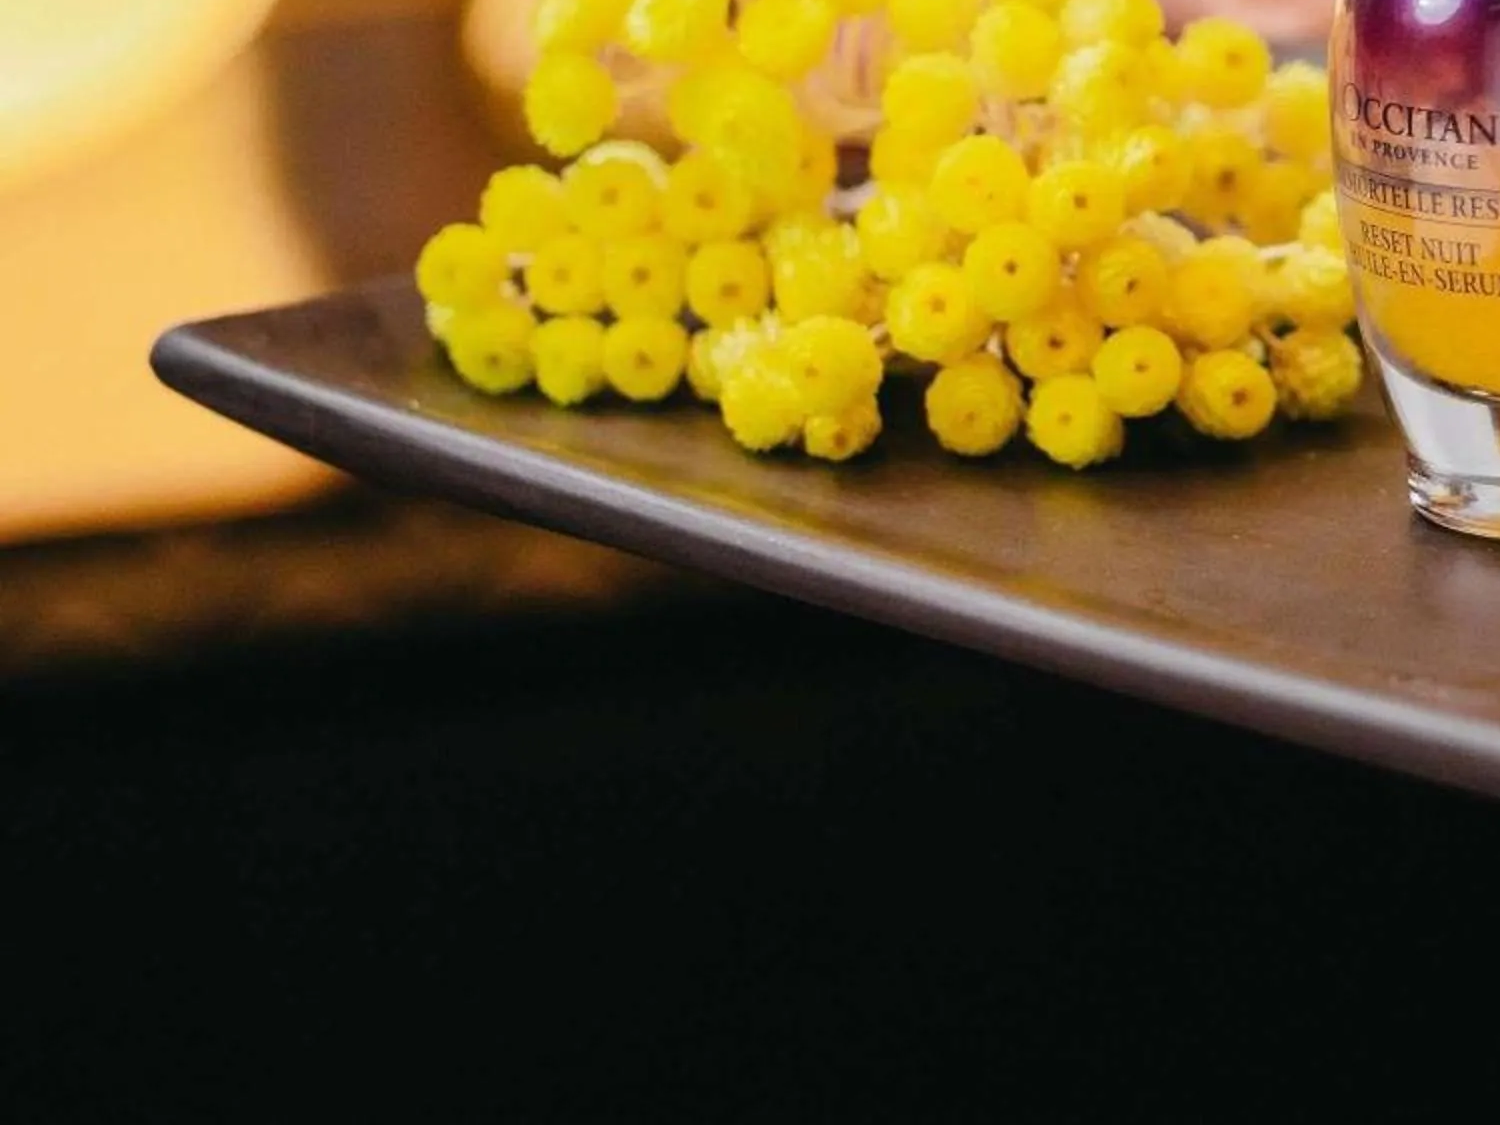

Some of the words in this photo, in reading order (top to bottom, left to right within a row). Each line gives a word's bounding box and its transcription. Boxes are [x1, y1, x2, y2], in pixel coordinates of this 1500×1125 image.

[1372, 139, 1480, 170] PROVENCE
[1360, 220, 1413, 257] RESET
[1421, 237, 1481, 266] NUIT
